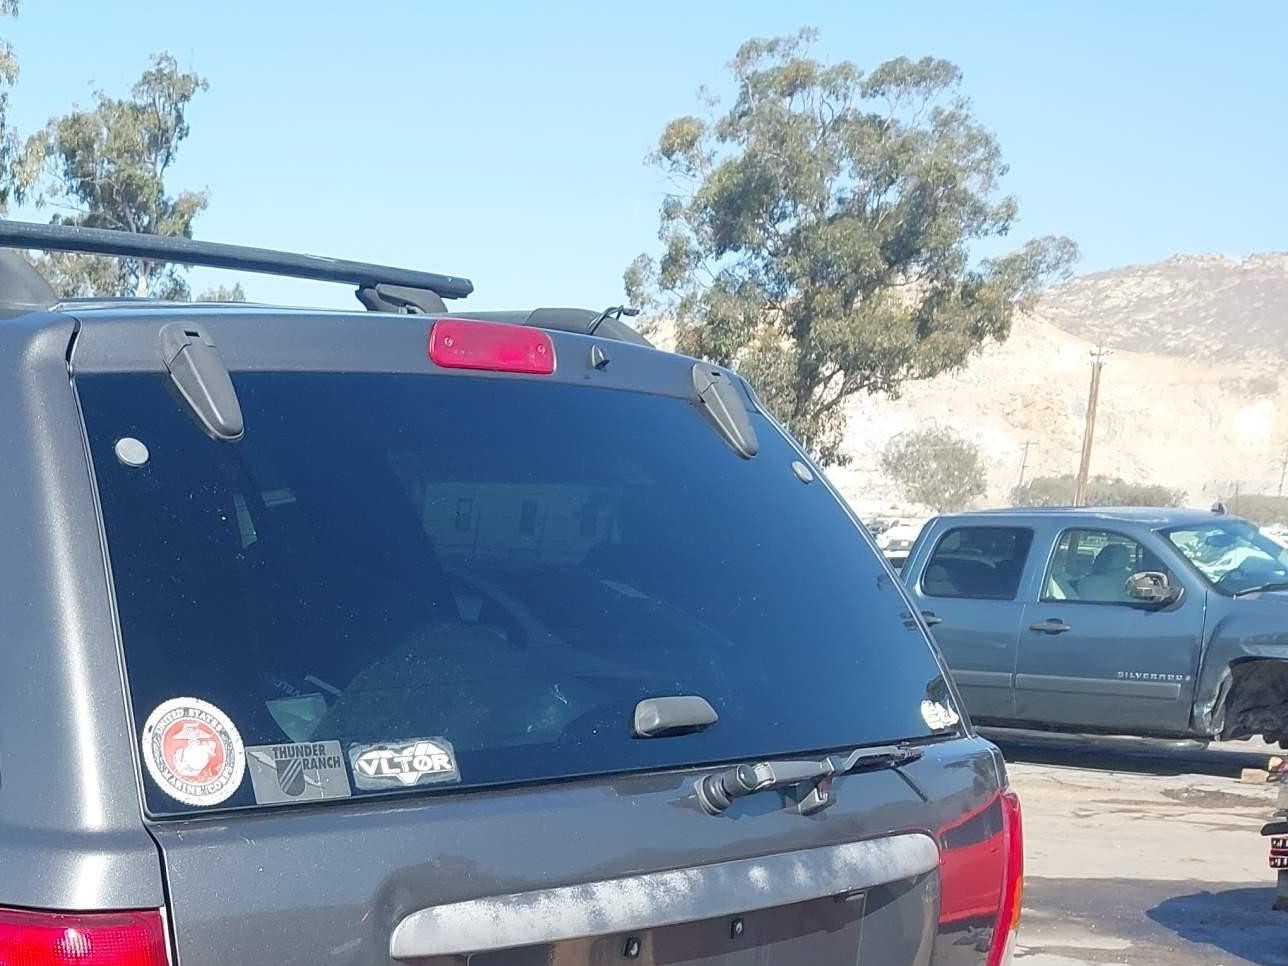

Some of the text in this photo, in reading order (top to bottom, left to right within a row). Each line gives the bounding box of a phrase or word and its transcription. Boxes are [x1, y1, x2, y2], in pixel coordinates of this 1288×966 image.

[156, 708, 223, 734] UNITED STATES
[272, 744, 326, 759] THUNDER
[302, 756, 341, 770] RANCH
[161, 769, 203, 796] MARINE
